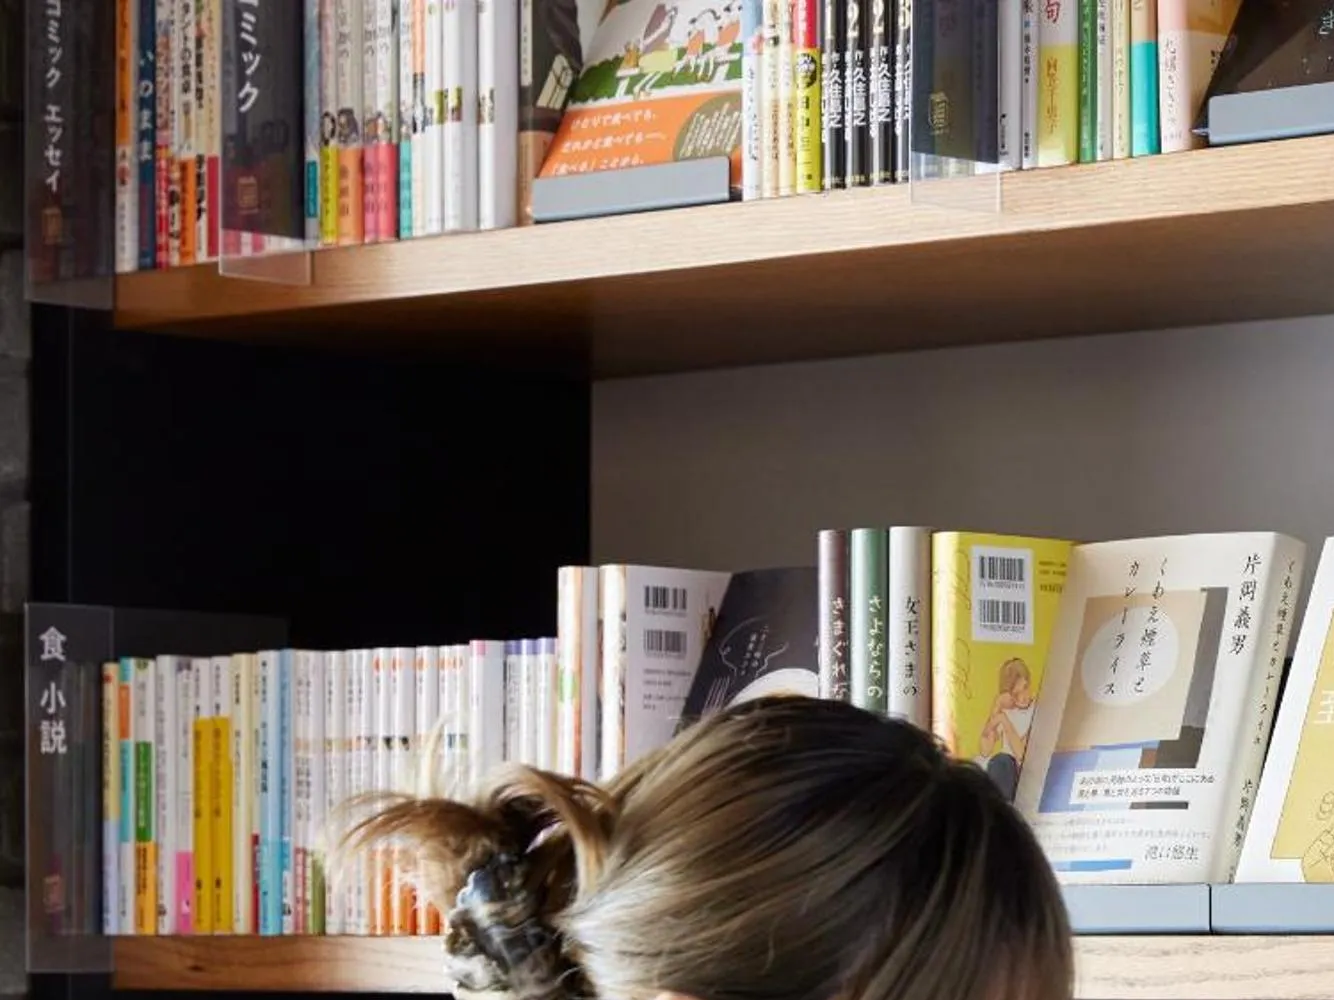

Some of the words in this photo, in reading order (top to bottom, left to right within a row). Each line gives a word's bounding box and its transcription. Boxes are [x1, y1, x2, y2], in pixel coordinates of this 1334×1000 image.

[237, 0, 260, 113] ミック
[43, 104, 63, 193] エッセイ
[39, 627, 67, 662] 食
[903, 596, 921, 697] 女王さまの
[1105, 560, 1140, 695] カレーライス
[1133, 556, 1169, 694] くわえ煙草と
[1229, 553, 1262, 656] 片岡義男
[40, 682, 67, 755] 小説
